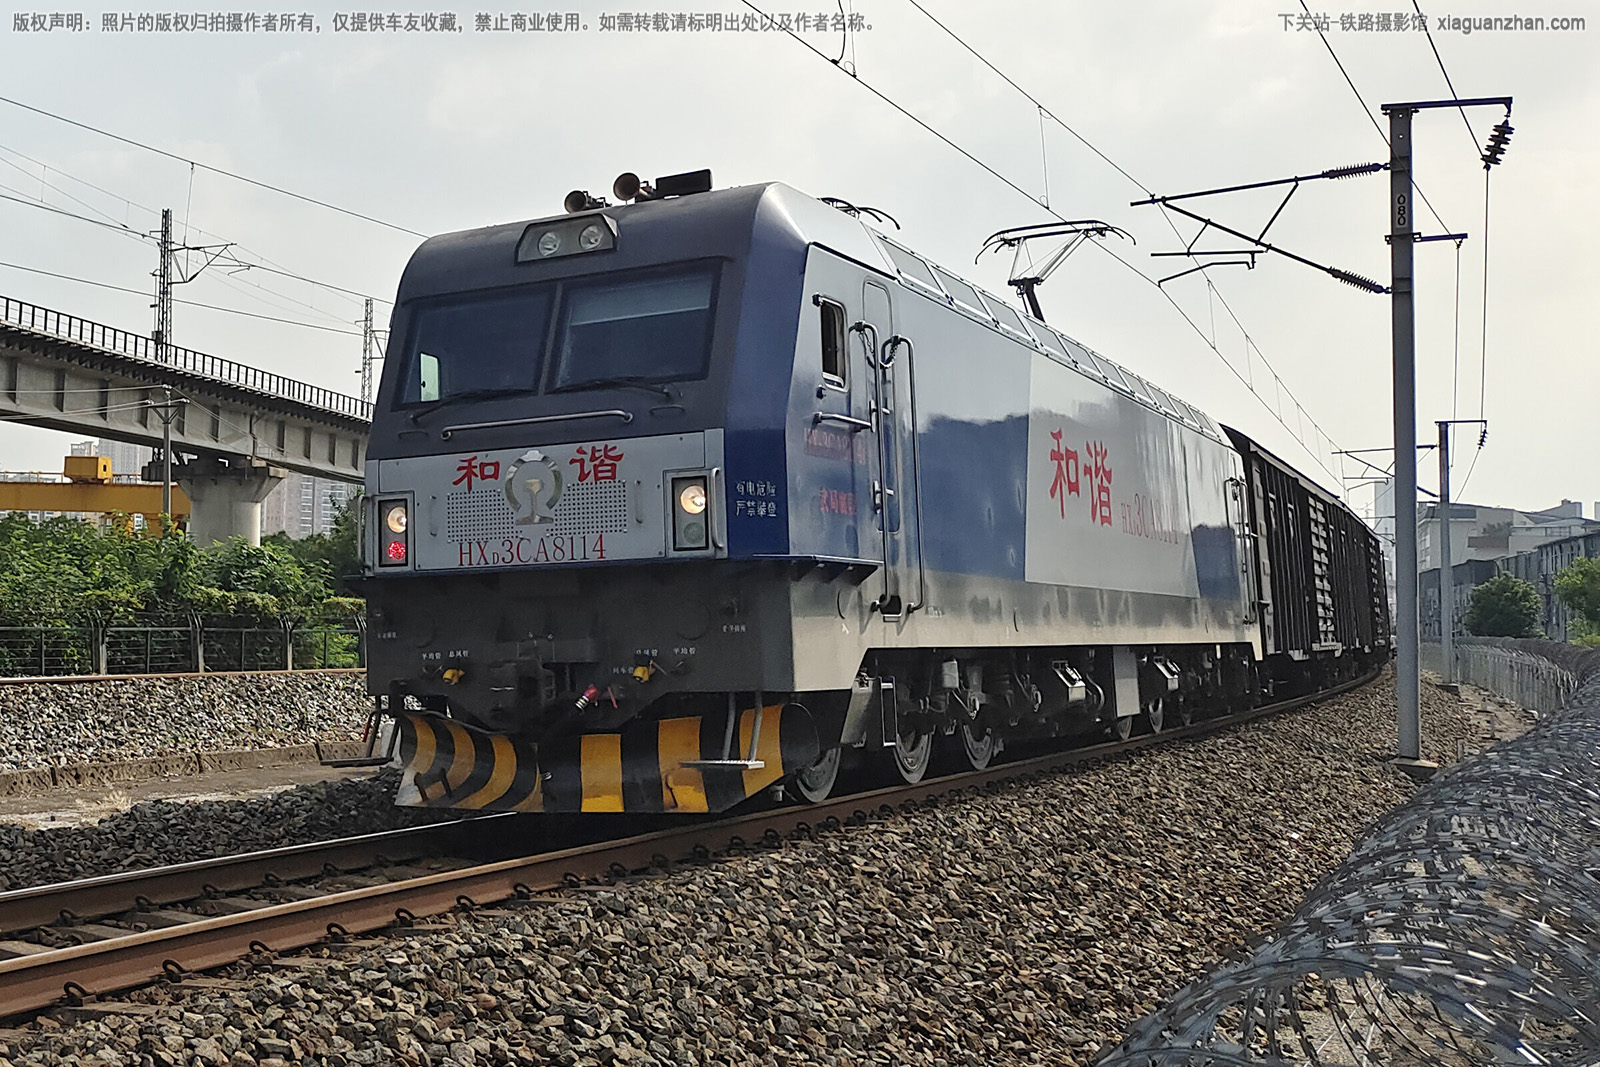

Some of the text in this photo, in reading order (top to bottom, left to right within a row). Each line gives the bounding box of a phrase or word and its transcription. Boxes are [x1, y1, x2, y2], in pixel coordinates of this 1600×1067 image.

[1397, 194, 1406, 226] 080
[453, 444, 624, 493] 和 谐
[1049, 428, 1112, 527] 和谐
[458, 534, 608, 567] HXD3CA8114
